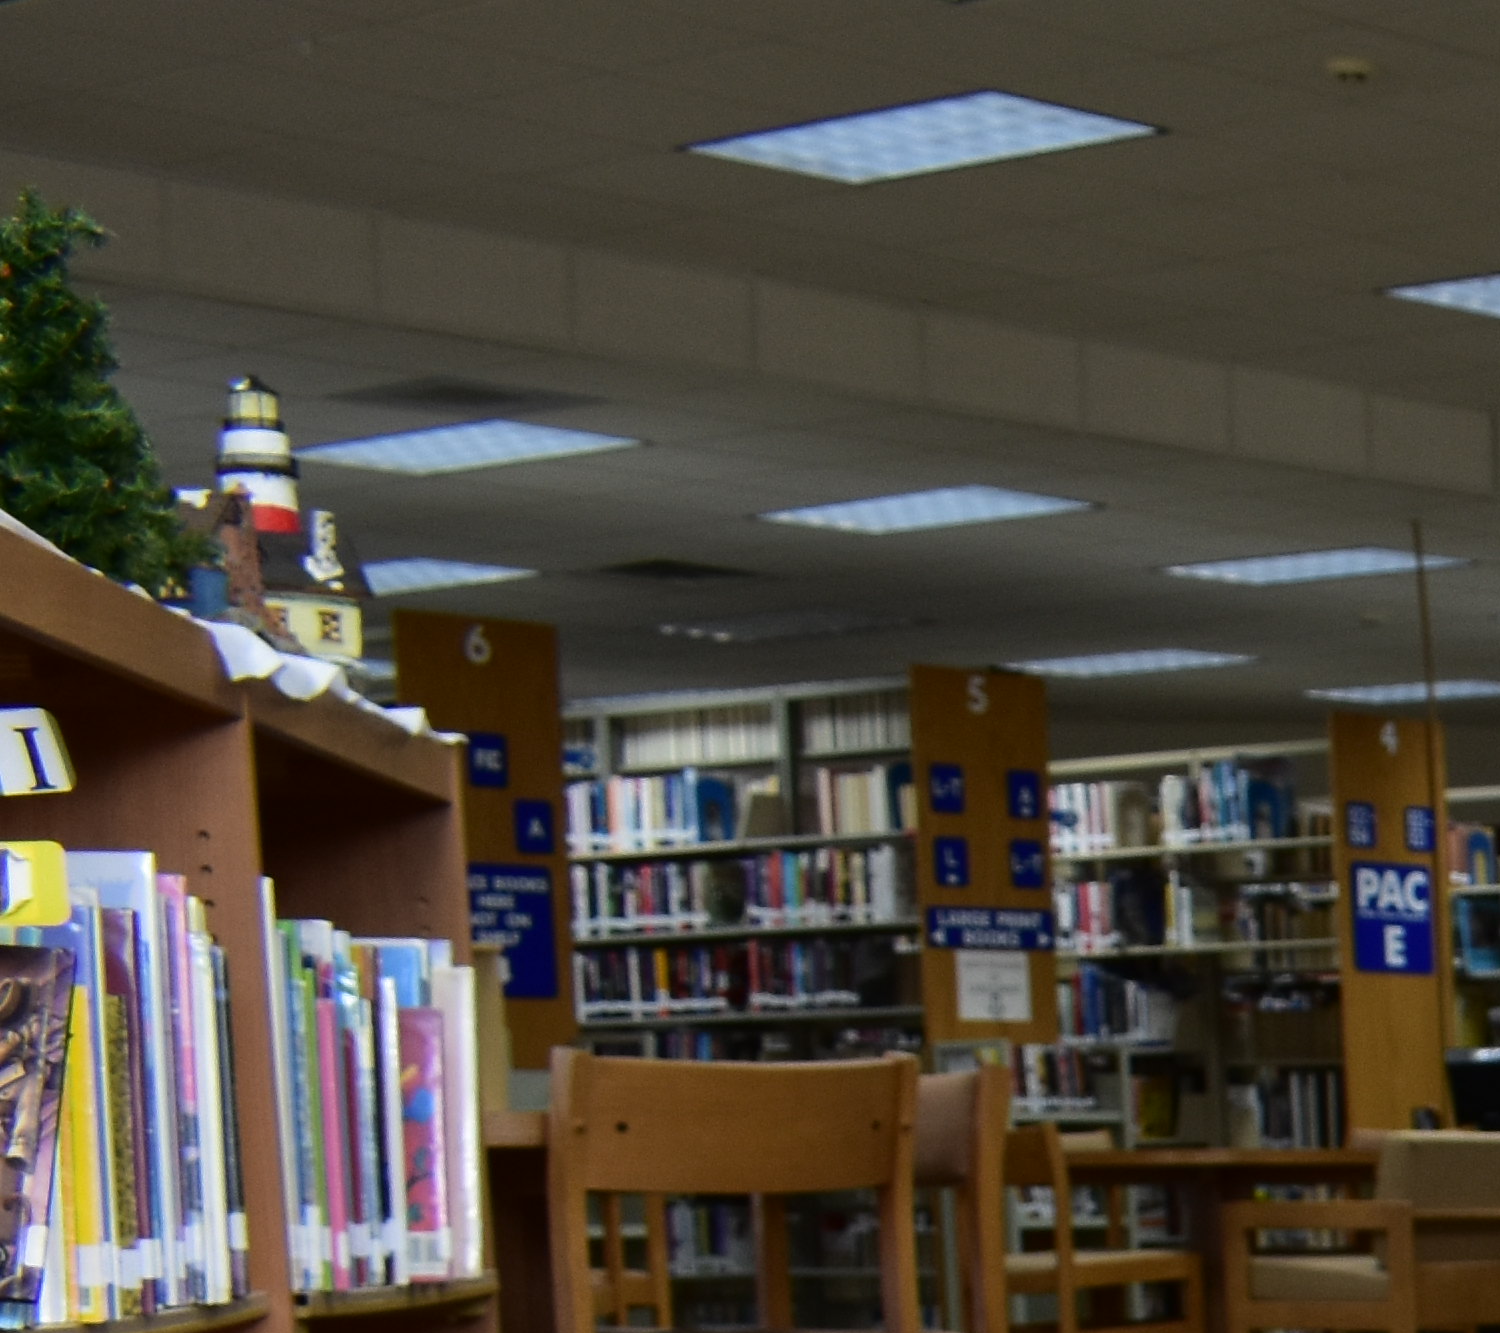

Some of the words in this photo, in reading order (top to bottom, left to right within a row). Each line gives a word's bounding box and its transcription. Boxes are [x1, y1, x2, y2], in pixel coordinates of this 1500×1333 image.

[463, 622, 493, 665] 6
[966, 674, 990, 715] 5
[13, 726, 57, 791] I
[527, 817, 546, 839] A
[1356, 867, 1428, 913] PAC
[1383, 924, 1408, 968] E
